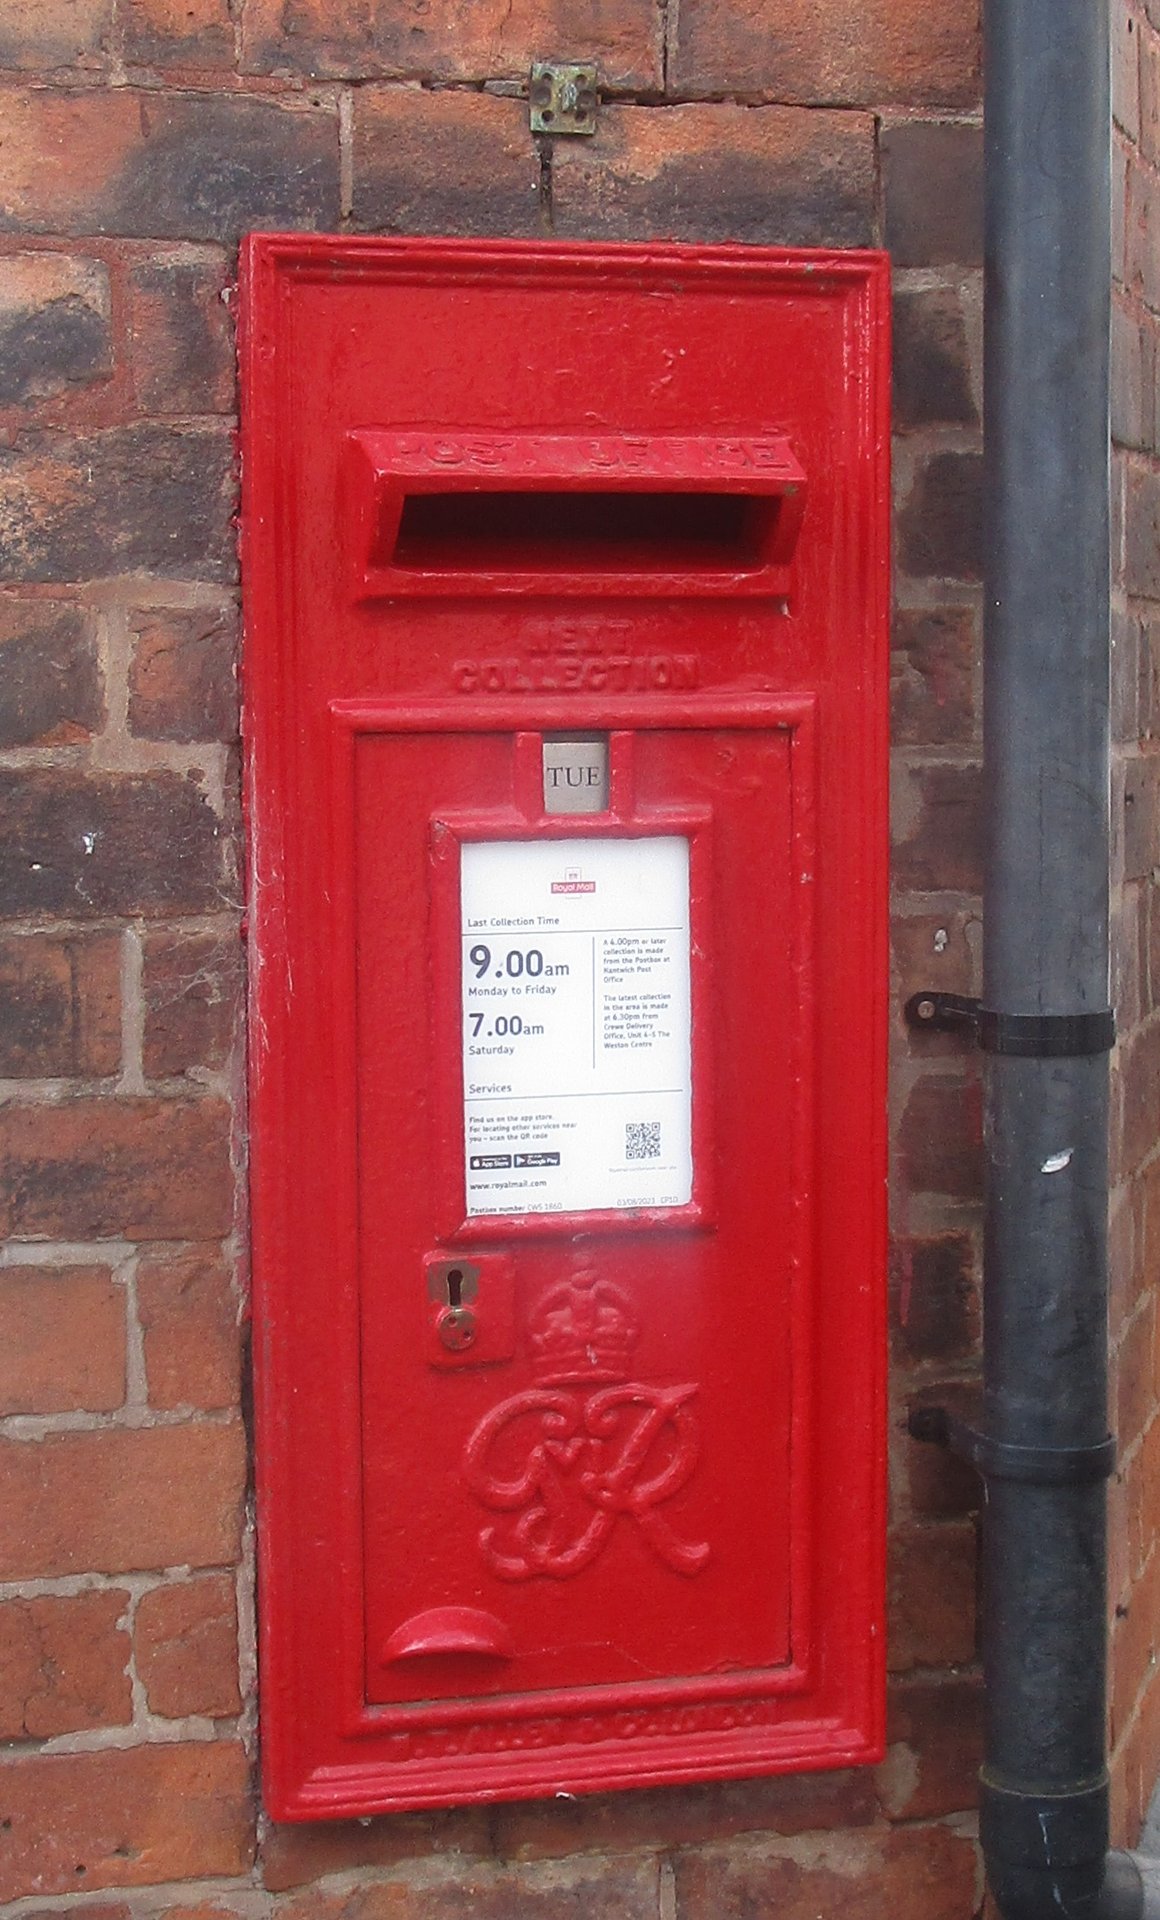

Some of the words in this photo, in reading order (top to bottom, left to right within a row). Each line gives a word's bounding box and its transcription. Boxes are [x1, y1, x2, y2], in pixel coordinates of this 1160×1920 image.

[523, 618, 632, 656] NEXT
[452, 654, 699, 692] COLLECTION
[547, 767, 601, 787] TUE
[552, 882, 576, 893] Royal
[576, 882, 594, 892] Mail
[468, 917, 488, 927] Last
[490, 917, 534, 926] Collection
[537, 916, 560, 926] Time
[610, 937, 640, 946] 4.00pm
[603, 947, 636, 956] collection
[469, 944, 570, 979] 9.00am
[603, 957, 620, 965] from
[635, 956, 662, 964] Postbox
[603, 976, 624, 984] Office
[468, 986, 508, 998] Monday
[511, 987, 522, 995] to
[525, 985, 557, 996] Friday
[612, 1013, 640, 1022] 6.30pm
[468, 1013, 544, 1038] 7.00am
[603, 1023, 624, 1031] Crewe
[625, 1022, 654, 1030] Delivery
[468, 1045, 514, 1056] Saturday
[469, 1083, 512, 1094] Services
[469, 1136, 482, 1144] you
[469, 1180, 547, 1190] www.royalmail.com
[499, 1205, 525, 1213] number
